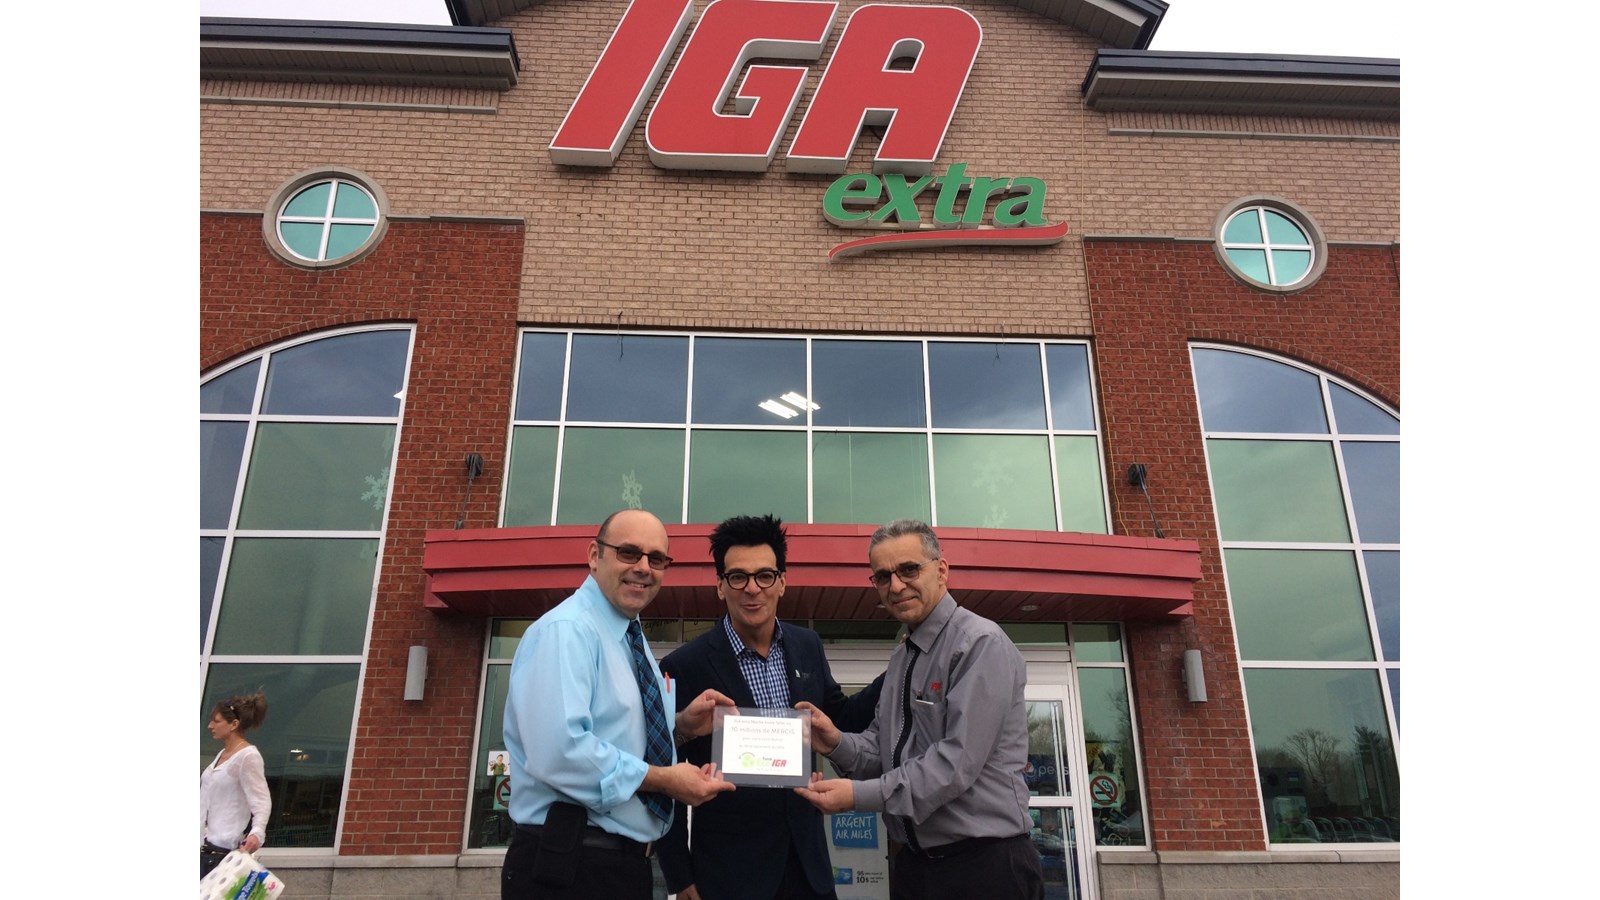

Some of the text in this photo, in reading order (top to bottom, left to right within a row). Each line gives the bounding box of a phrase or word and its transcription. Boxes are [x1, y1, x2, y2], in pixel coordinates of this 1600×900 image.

[549, 0, 984, 172] IGA
[822, 162, 1048, 228] extra
[771, 759, 787, 767] IGA
[1039, 765, 1070, 777] pes
[835, 815, 874, 828] ARGENT
[835, 829, 873, 840] AIR MILES
